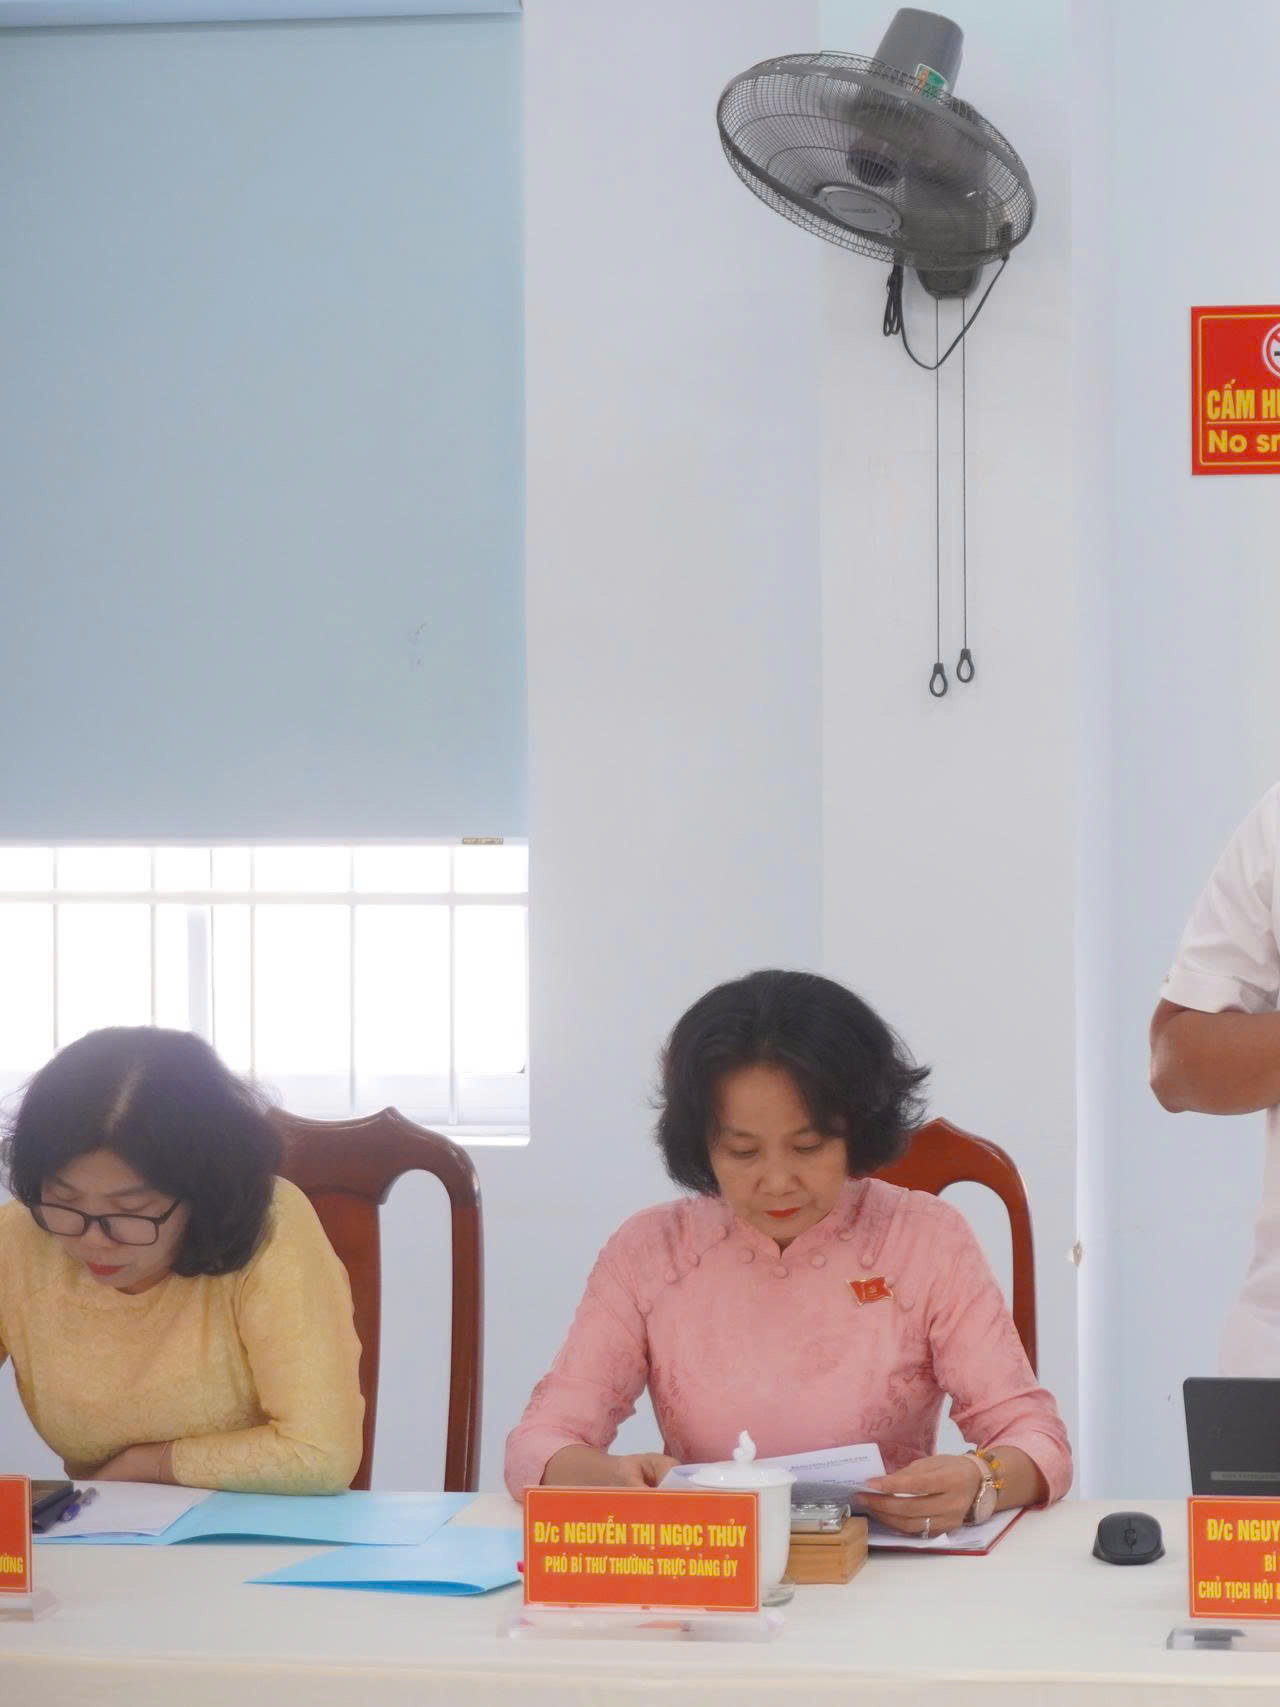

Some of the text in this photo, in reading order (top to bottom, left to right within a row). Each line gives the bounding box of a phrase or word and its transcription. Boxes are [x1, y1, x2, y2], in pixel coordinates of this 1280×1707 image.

[1206, 378, 1255, 419] CẤM
[1208, 430, 1247, 453] No
[534, 1514, 747, 1550] Đ/c NGUYỄN THỊ NGỌC THỦY
[1207, 1518, 1233, 1542] Đ/c
[544, 1552, 738, 1579] PHÓ BÍ THƯ THƯỜNG TRỰC ĐẢNG ỦY
[1264, 1550, 1277, 1572] BÍ
[1198, 1575, 1222, 1598] CHỦ
[1225, 1581, 1250, 1602] TỊCH
[1253, 1578, 1273, 1603] HỘI
